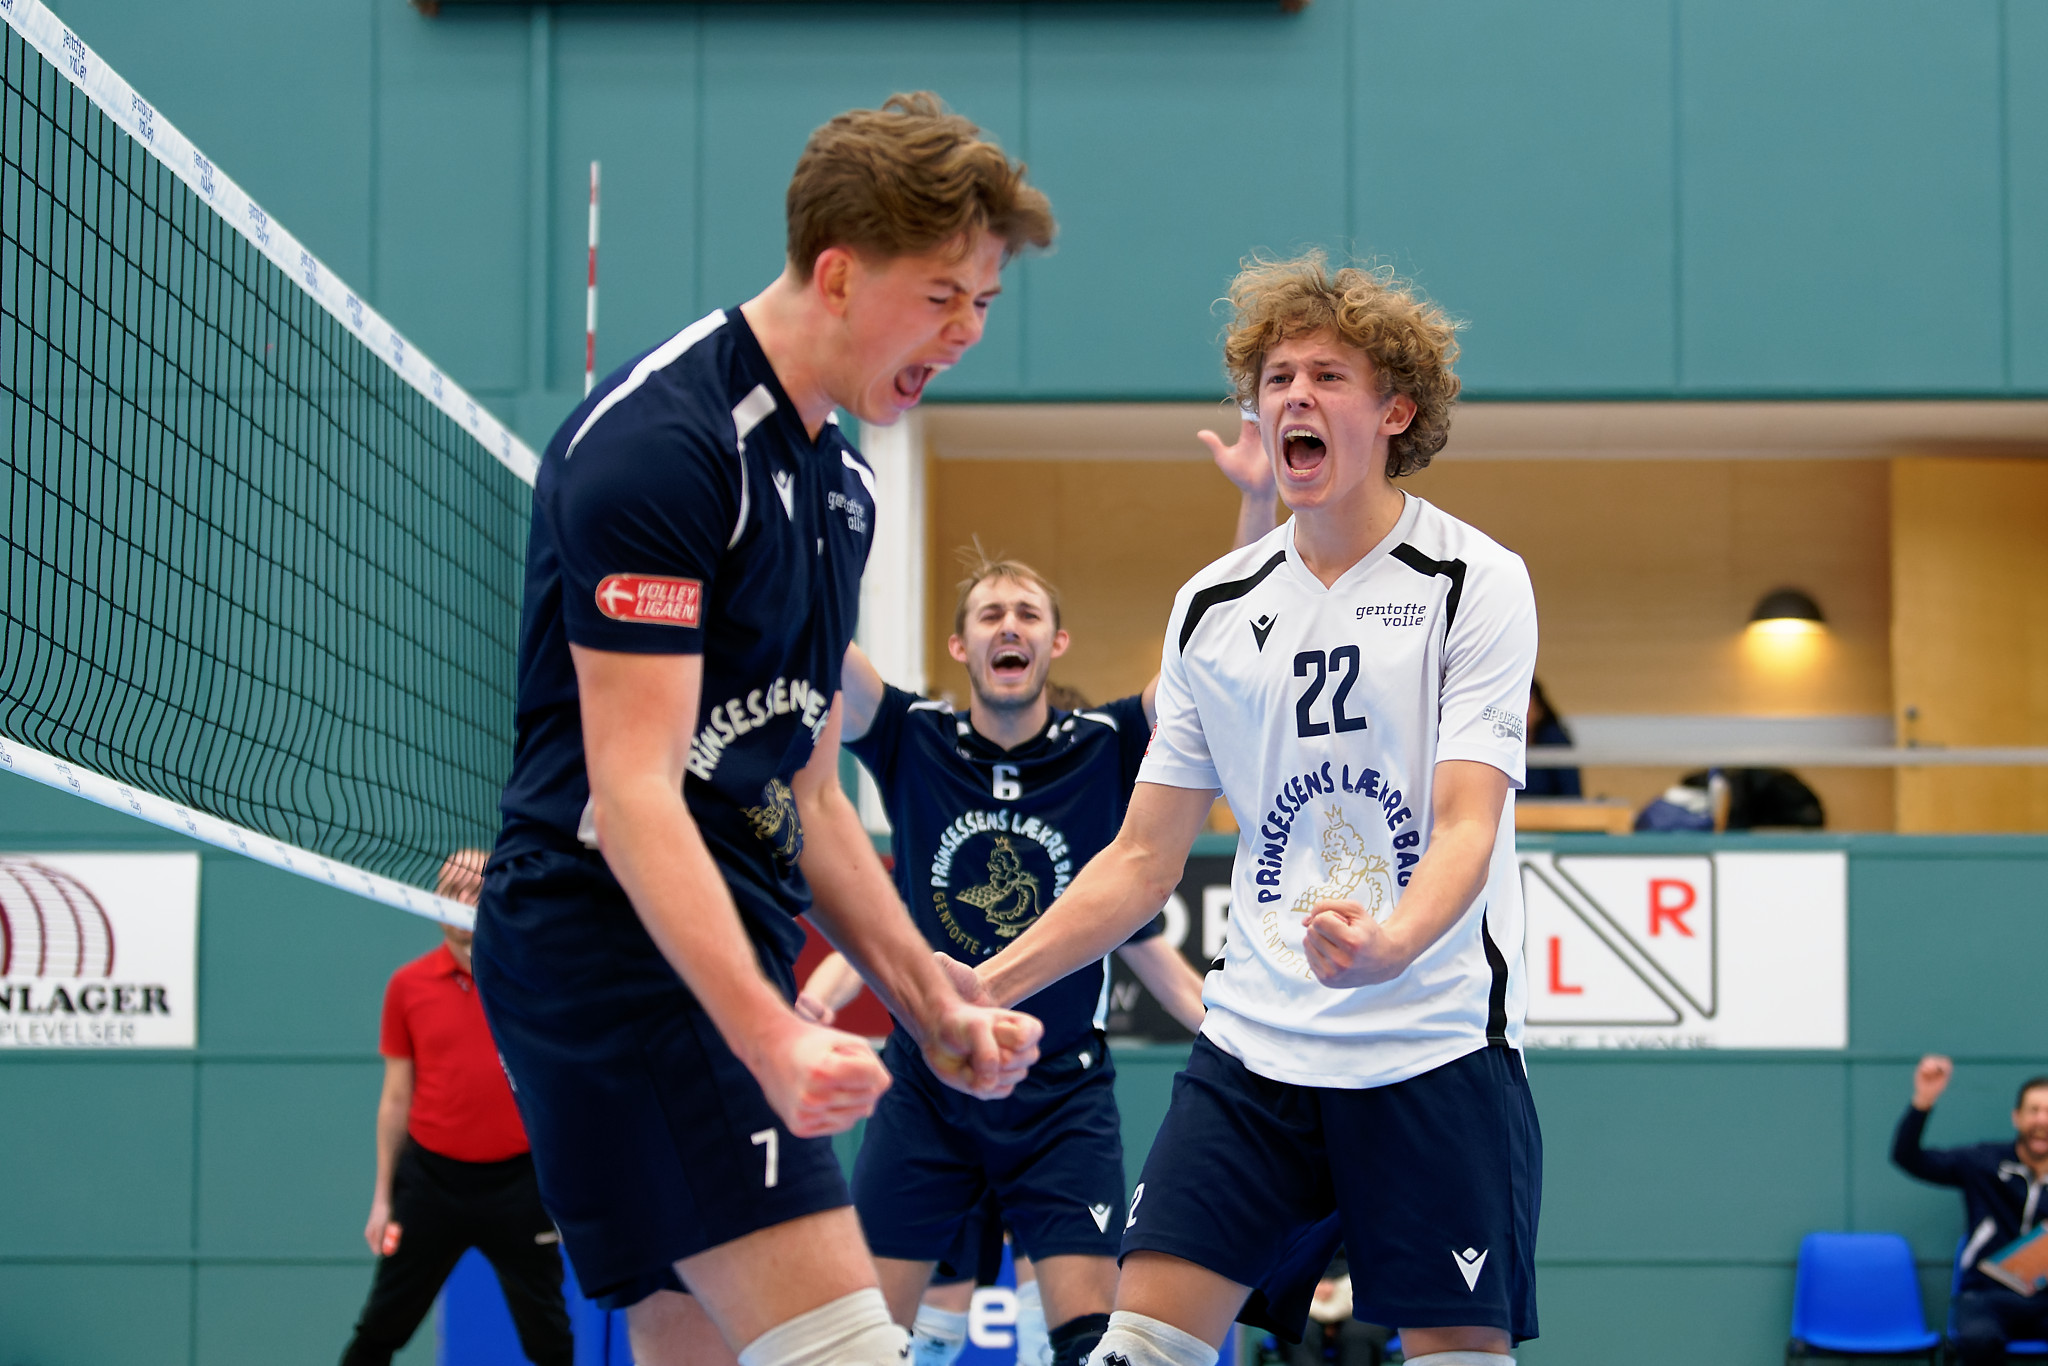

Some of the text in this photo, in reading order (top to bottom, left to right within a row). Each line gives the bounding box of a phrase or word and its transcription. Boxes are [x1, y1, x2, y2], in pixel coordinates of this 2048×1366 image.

[635, 599, 695, 621] LIGAEN
[637, 581, 696, 602] VOLLEY
[1356, 602, 1427, 620] gentofte
[1382, 615, 1426, 627] volle
[1293, 644, 1368, 738] 22
[992, 764, 1020, 801] 6
[1342, 764, 1412, 832] LÆKRE
[1011, 812, 1070, 862] LÆKRE
[932, 891, 981, 956] GENTOFTE
[1648, 878, 1697, 938] R
[1549, 936, 1584, 995] L
[750, 1127, 779, 1188] 7
[1123, 1182, 1145, 1234] 2
